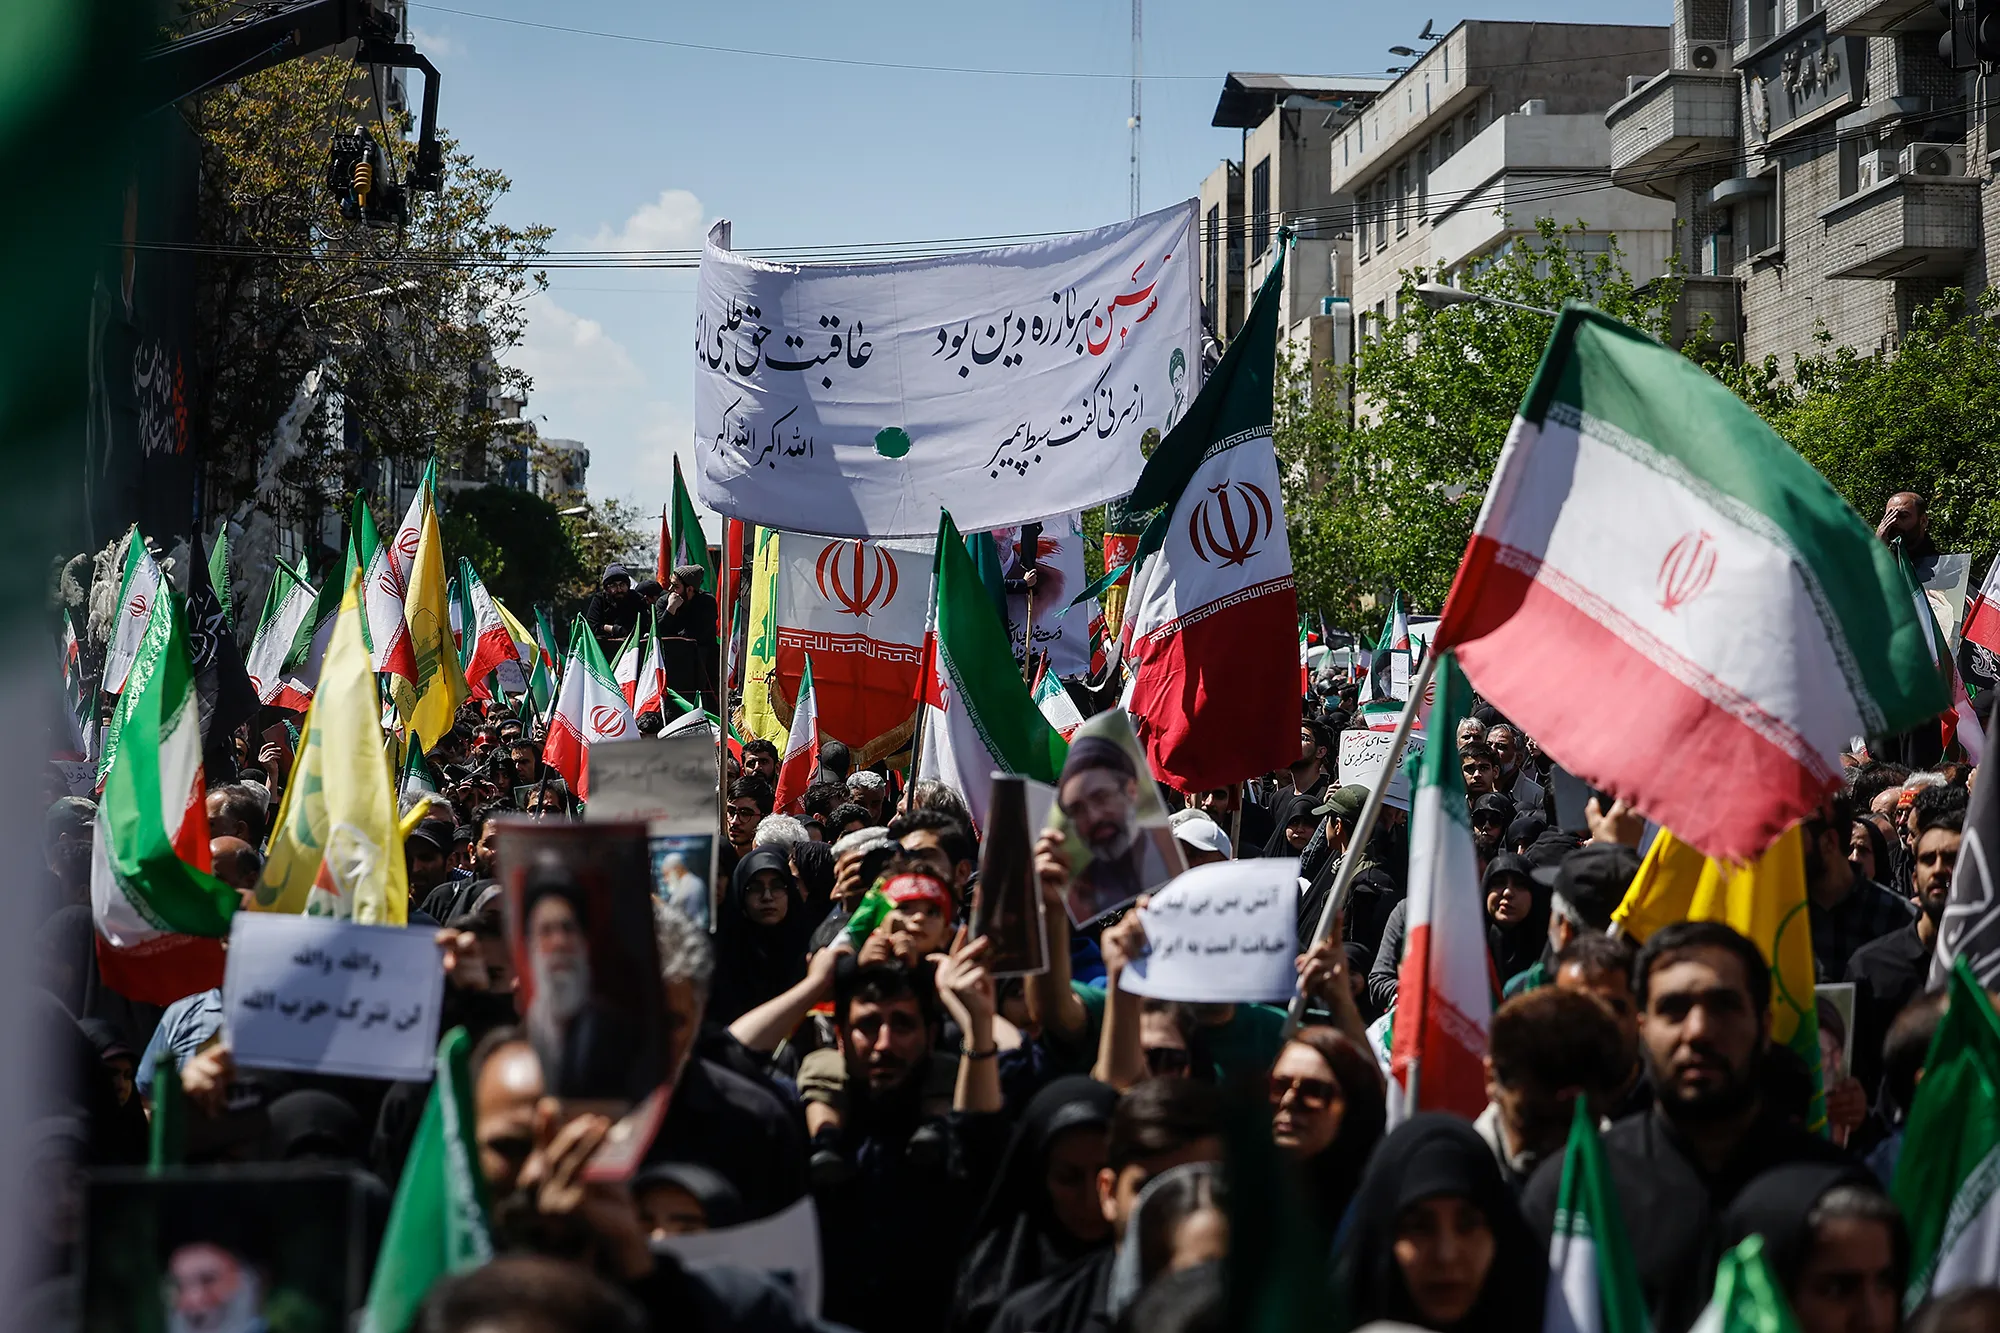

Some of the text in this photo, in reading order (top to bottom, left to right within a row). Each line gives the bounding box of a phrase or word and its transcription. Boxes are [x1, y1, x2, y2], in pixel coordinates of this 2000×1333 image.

[764, 314, 874, 390] عاقبت
[931, 321, 971, 379] بود
[971, 309, 1024, 369] دین
[710, 396, 742, 458] اکبر
[729, 416, 756, 450] الله
[1046, 361, 1113, 448] گفت
[752, 405, 799, 470] اکبر
[782, 426, 815, 459] الله
